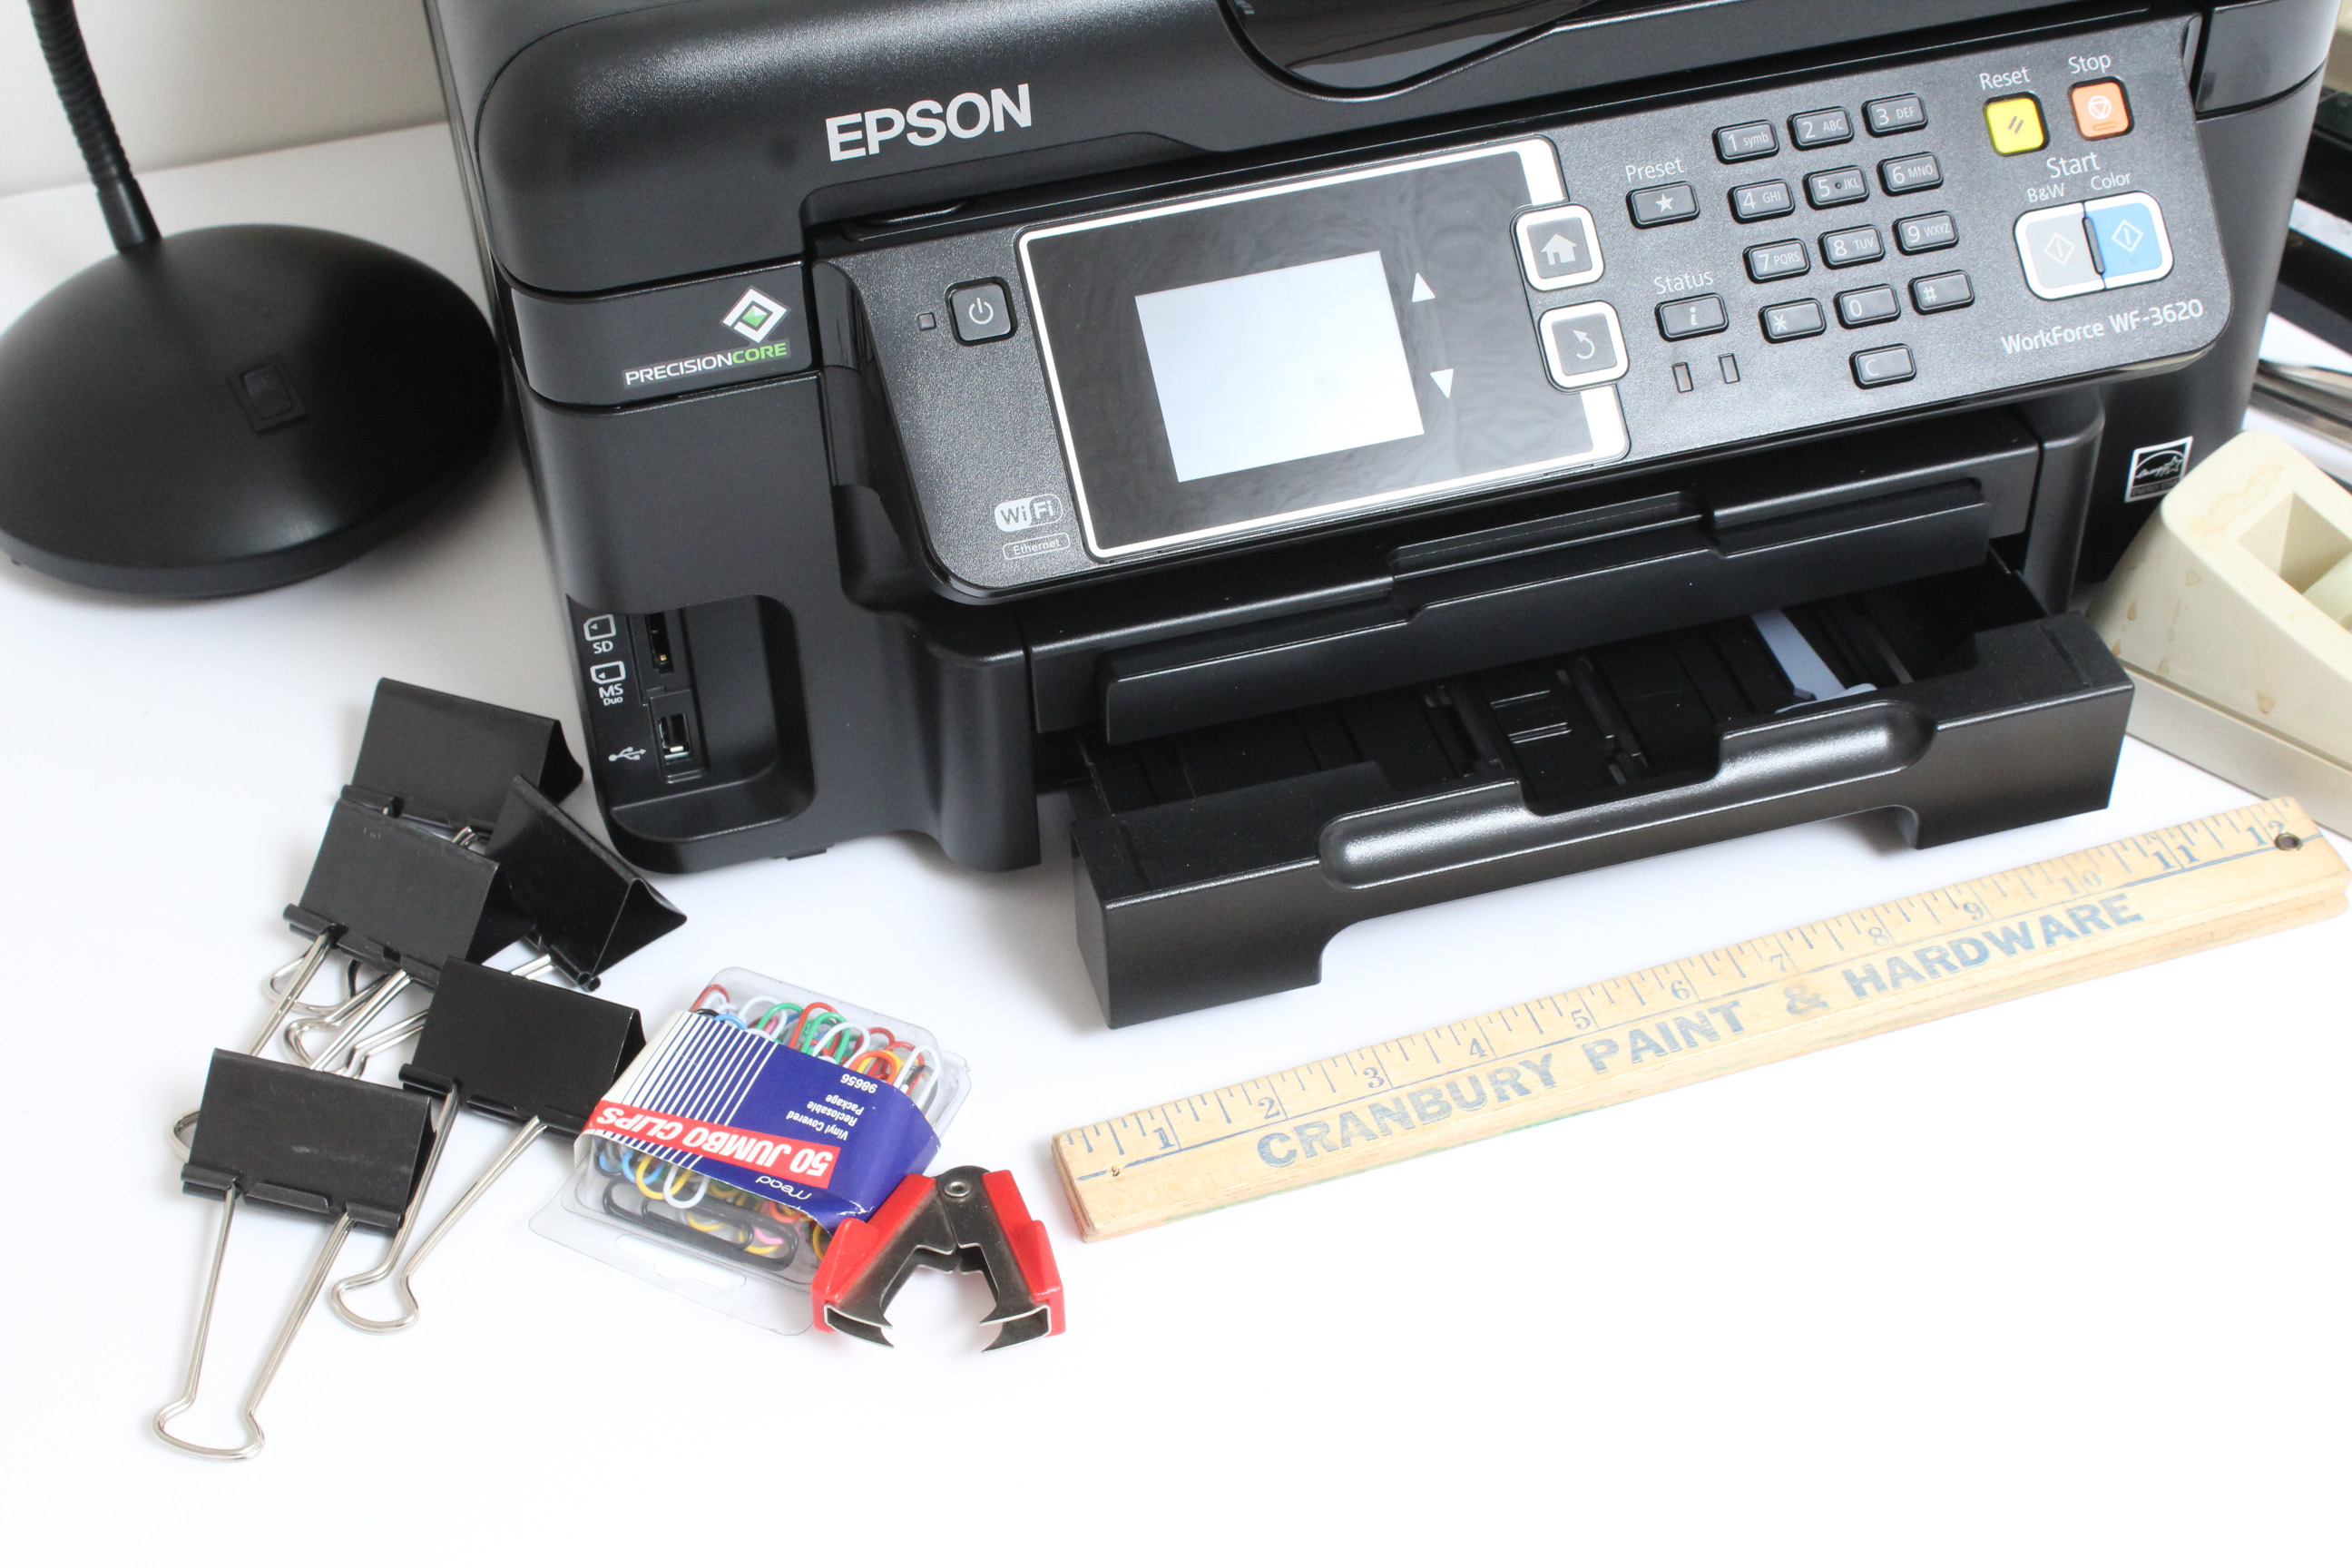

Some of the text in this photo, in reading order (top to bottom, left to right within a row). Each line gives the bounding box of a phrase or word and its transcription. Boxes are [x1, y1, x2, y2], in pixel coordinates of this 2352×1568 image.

[2068, 54, 2112, 74] Stop
[1979, 66, 2031, 91] Reset
[826, 83, 1033, 162] EPSON
[1876, 106, 1915, 125] 3 DEF
[1802, 119, 1844, 139] 2 ABC
[1727, 132, 1769, 152] 1 symb
[1625, 157, 1684, 182] Preset
[1892, 163, 1934, 184] 6 MNO
[2046, 152, 2101, 179] Start
[1818, 177, 1860, 197] 5 JKL
[2026, 172, 2131, 203] B&W Color
[1743, 191, 1781, 209] 4 GHI
[1907, 222, 1951, 242] 9 WXYZ
[1834, 237, 1875, 256] 8 TUV
[1758, 251, 1800, 271] 7 PQRS
[1654, 271, 1714, 295] Status
[1924, 286, 1937, 302] #
[1850, 299, 1861, 317] 0
[2001, 299, 2203, 354] WorkForce WF-3620
[1865, 359, 1879, 377] C
[1013, 538, 1061, 555] Ethernet
[593, 641, 613, 653] SD
[599, 683, 624, 699] MS
[603, 696, 623, 706] Duo
[1152, 1126, 1176, 1152] 1
[1258, 1096, 1282, 1121] 2
[1362, 1065, 1386, 1091] 3
[1466, 1037, 1489, 1060] 4
[1572, 1009, 1593, 1031] 5
[1671, 979, 1691, 1001] 6
[1769, 953, 1788, 974] 7
[1868, 926, 1890, 947] 8
[1963, 901, 1985, 921] 9
[2059, 870, 2102, 895] 10
[2152, 844, 2201, 872] 11
[1258, 892, 2146, 1169] CRANBURY PAINT & HARDWARE
[840, 1073, 878, 1093] 98656
[807, 1101, 858, 1127] Reclosable
[825, 1094, 865, 1115] Package
[786, 1110, 849, 1142] Vinyl Covered
[597, 1107, 835, 1178] 50 JUMBO CLIPS
[755, 1176, 813, 1201] mead
